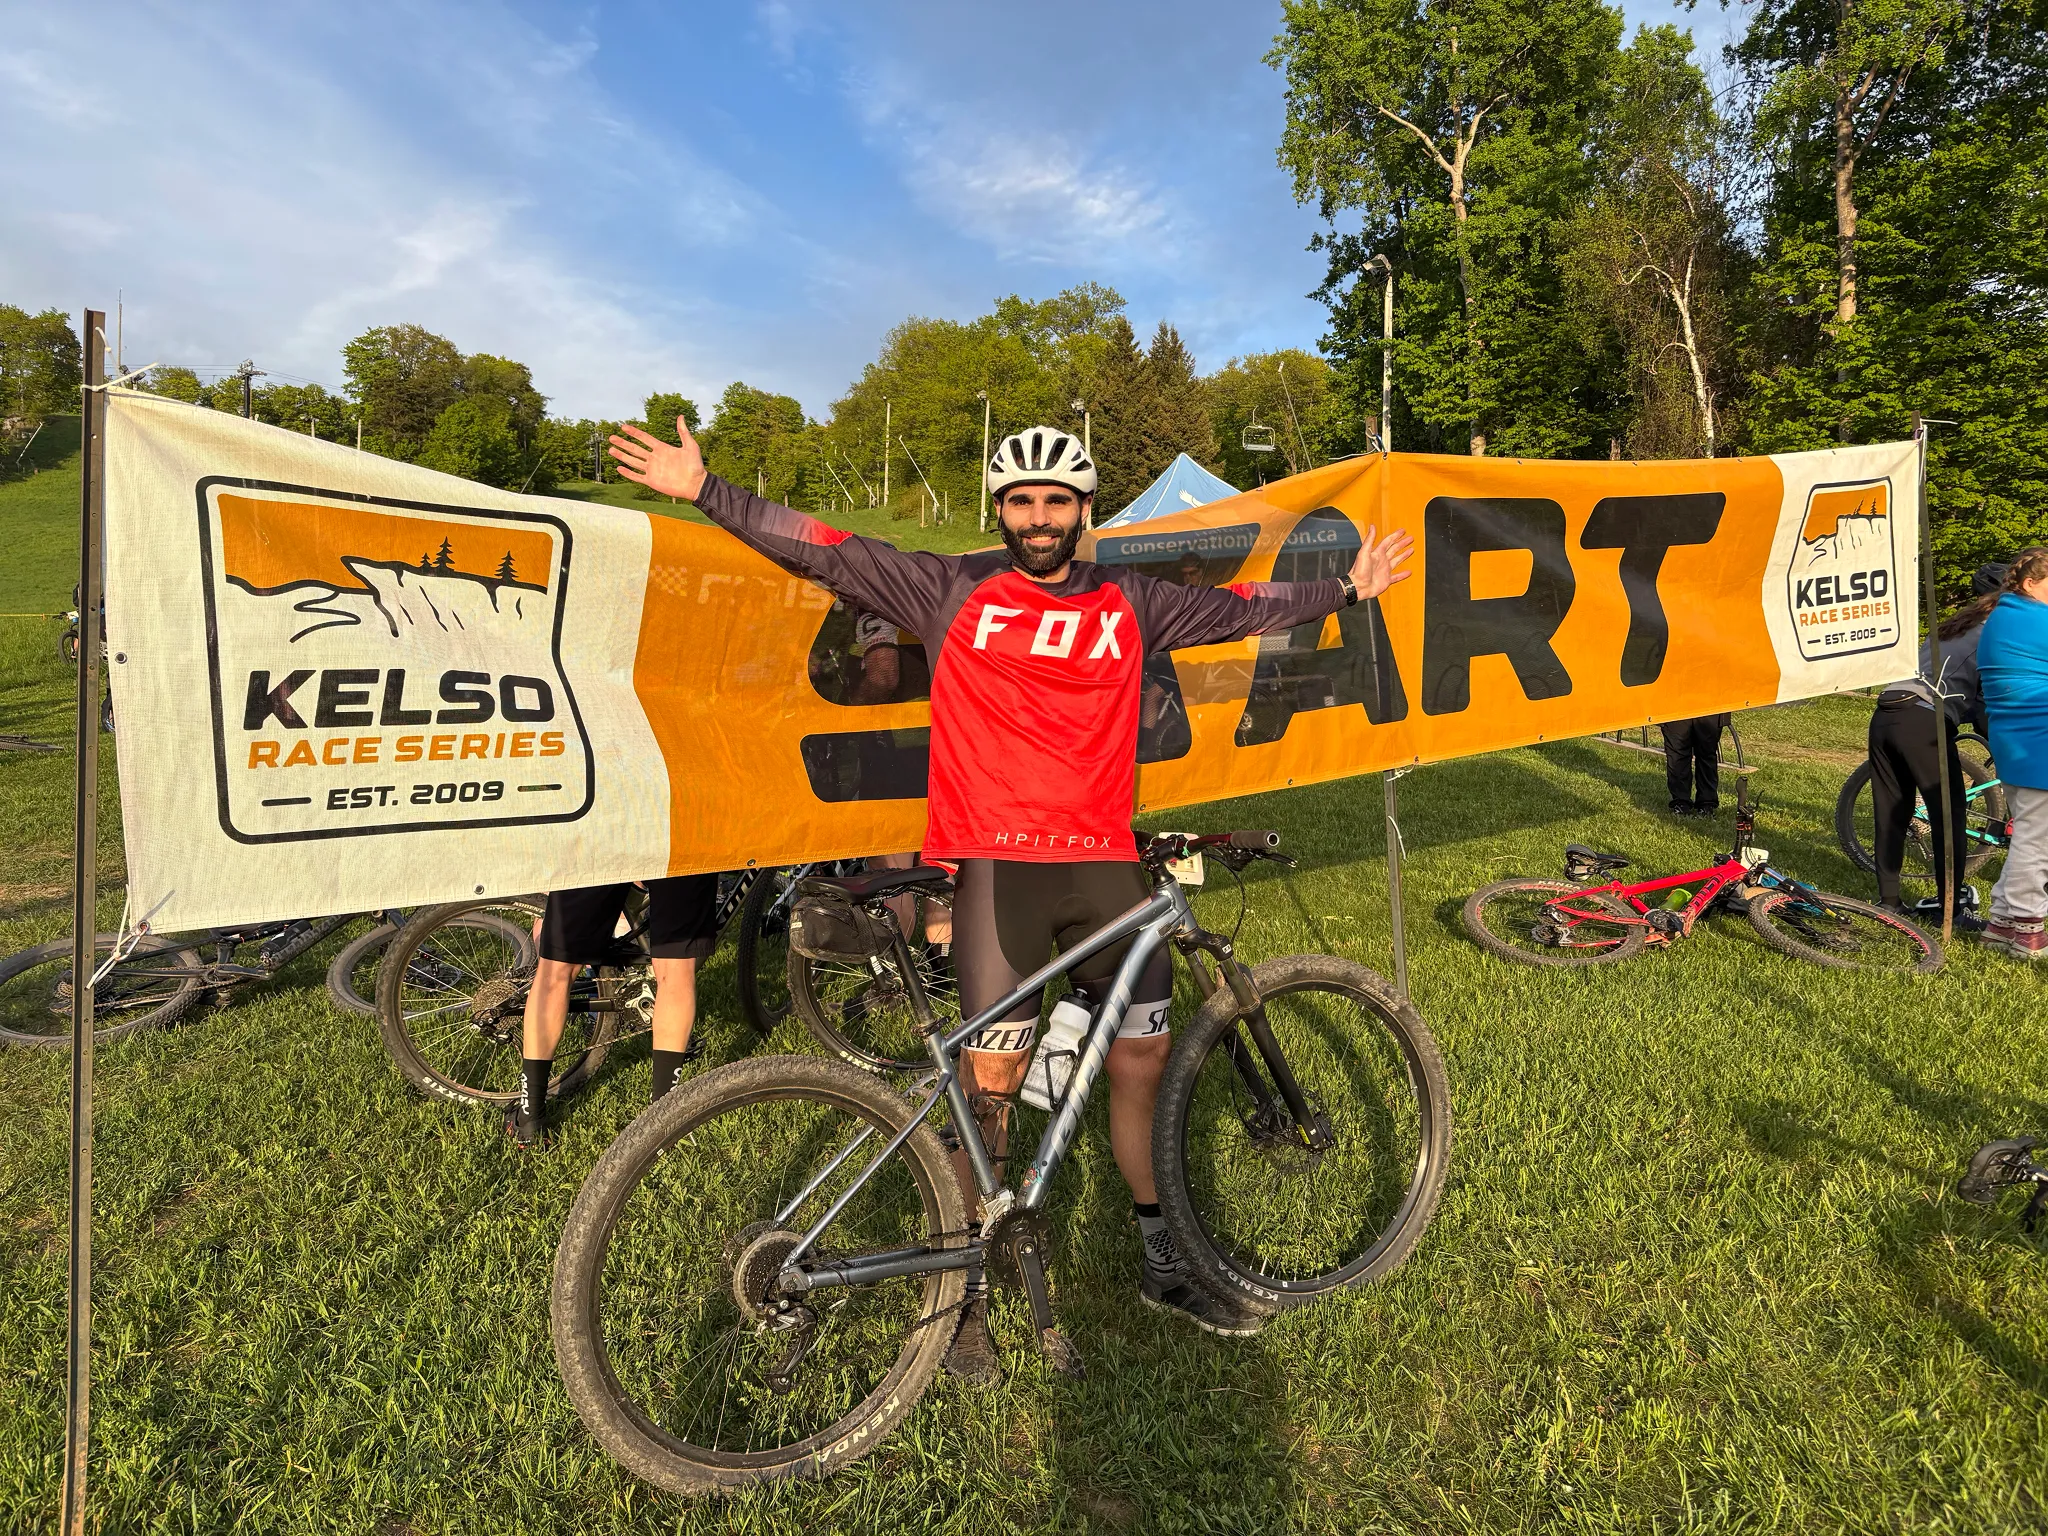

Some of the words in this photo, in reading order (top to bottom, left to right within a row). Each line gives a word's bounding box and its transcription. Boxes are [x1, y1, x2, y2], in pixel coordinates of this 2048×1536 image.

[1796, 569, 1888, 609] KELSO
[972, 604, 1123, 660] FOX
[1799, 608, 1839, 627] RACE
[1841, 601, 1891, 621] SERIES
[1825, 632, 1848, 645] EST.
[1850, 627, 1877, 641] 2009
[243, 668, 556, 731] KELSO
[247, 736, 383, 770] RACE
[394, 731, 566, 763] SERIES
[326, 785, 400, 811] EST.
[409, 780, 505, 805] 2009
[1764, 892, 1788, 902] KEND
[963, 1025, 1033, 1051] LIZED
[1218, 1259, 1279, 1302] KENDA
[817, 1395, 900, 1463] KENDA
